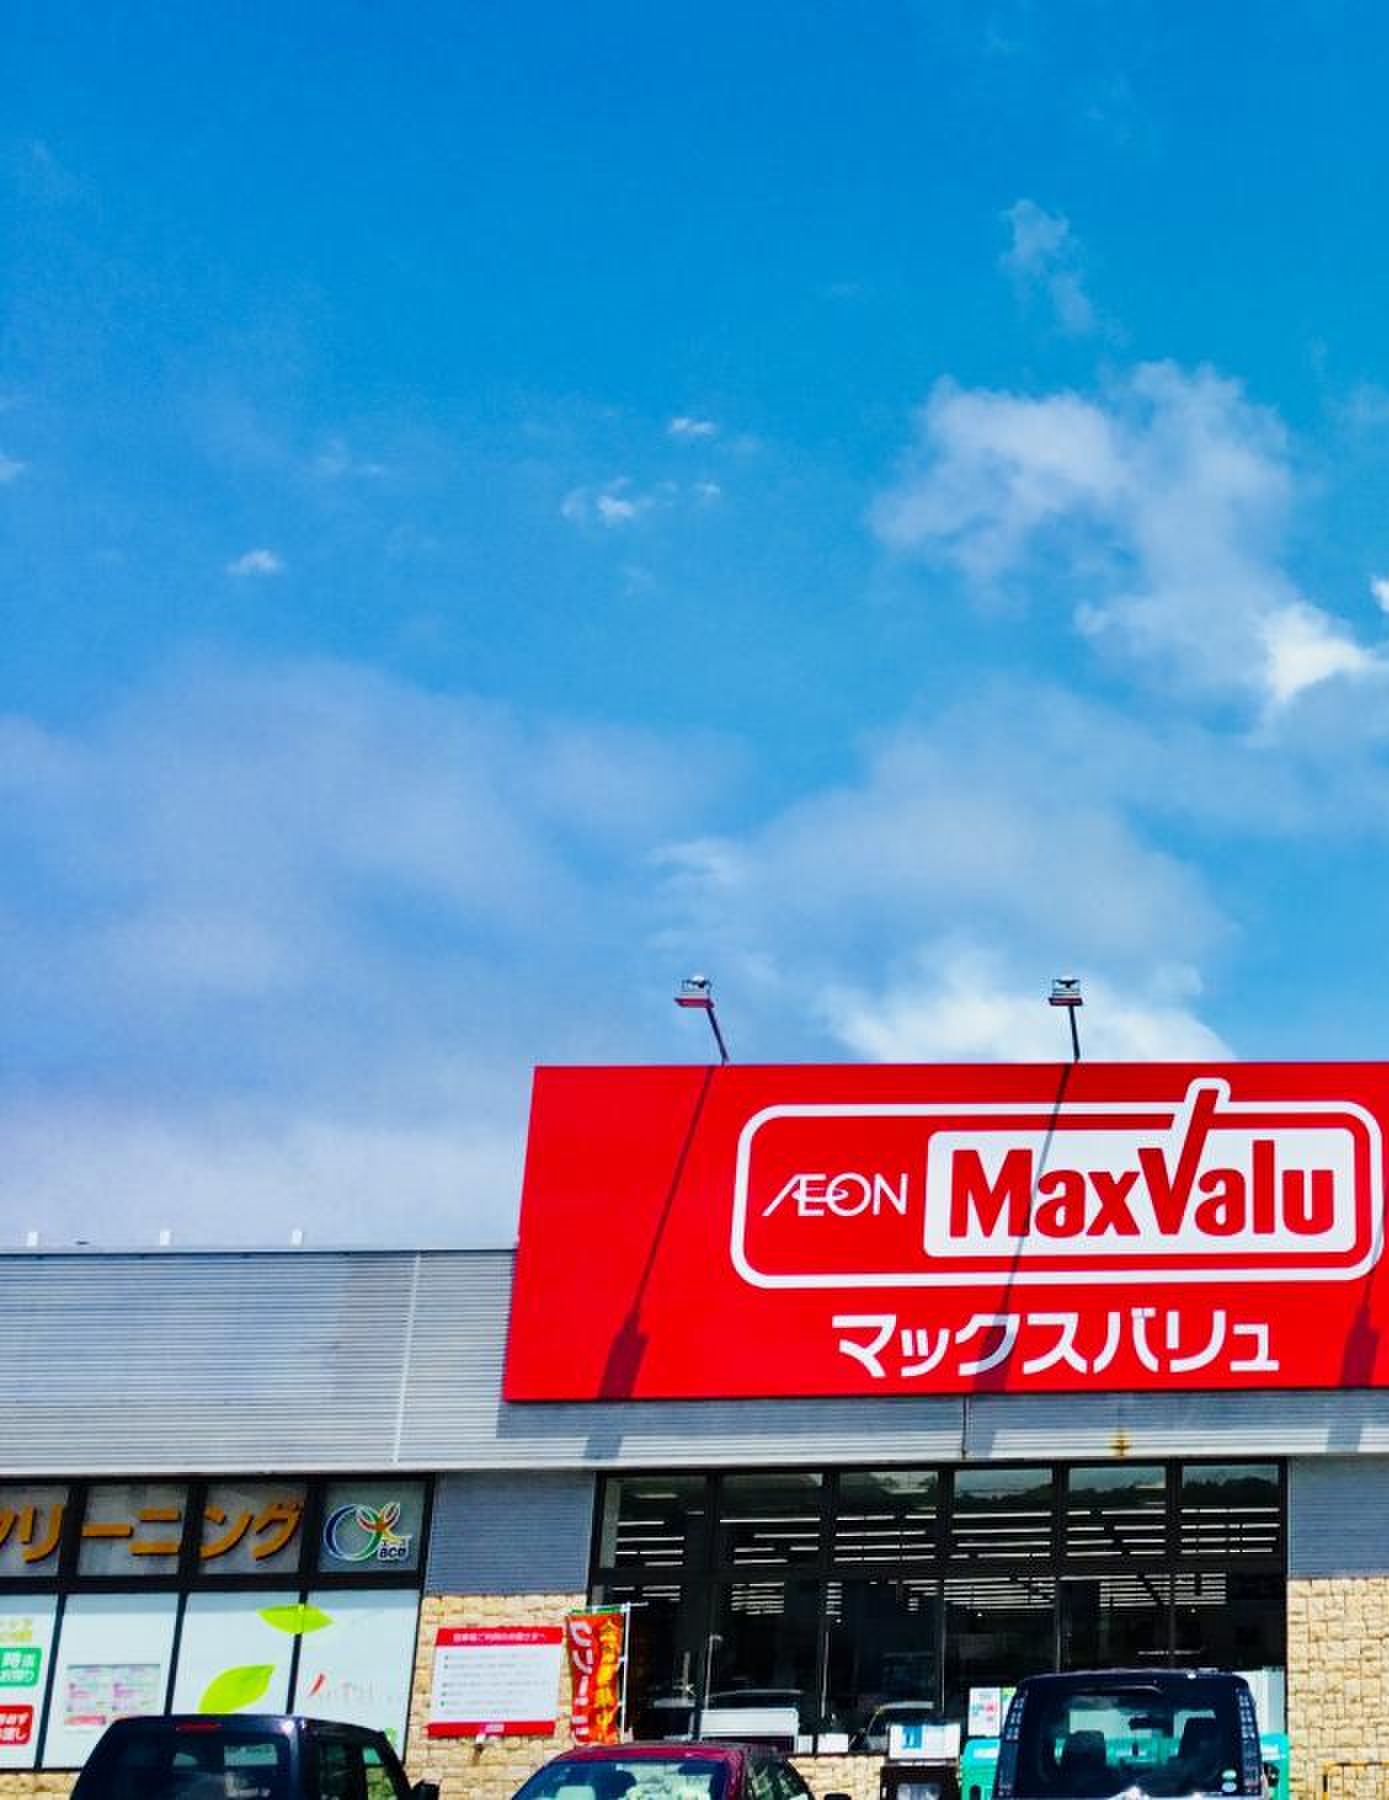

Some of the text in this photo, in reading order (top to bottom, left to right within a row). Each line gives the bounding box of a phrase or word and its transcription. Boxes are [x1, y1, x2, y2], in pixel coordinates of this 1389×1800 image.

[948, 1089, 1335, 1238] MaxValu
[831, 1307, 1280, 1378] マックスバリュ
